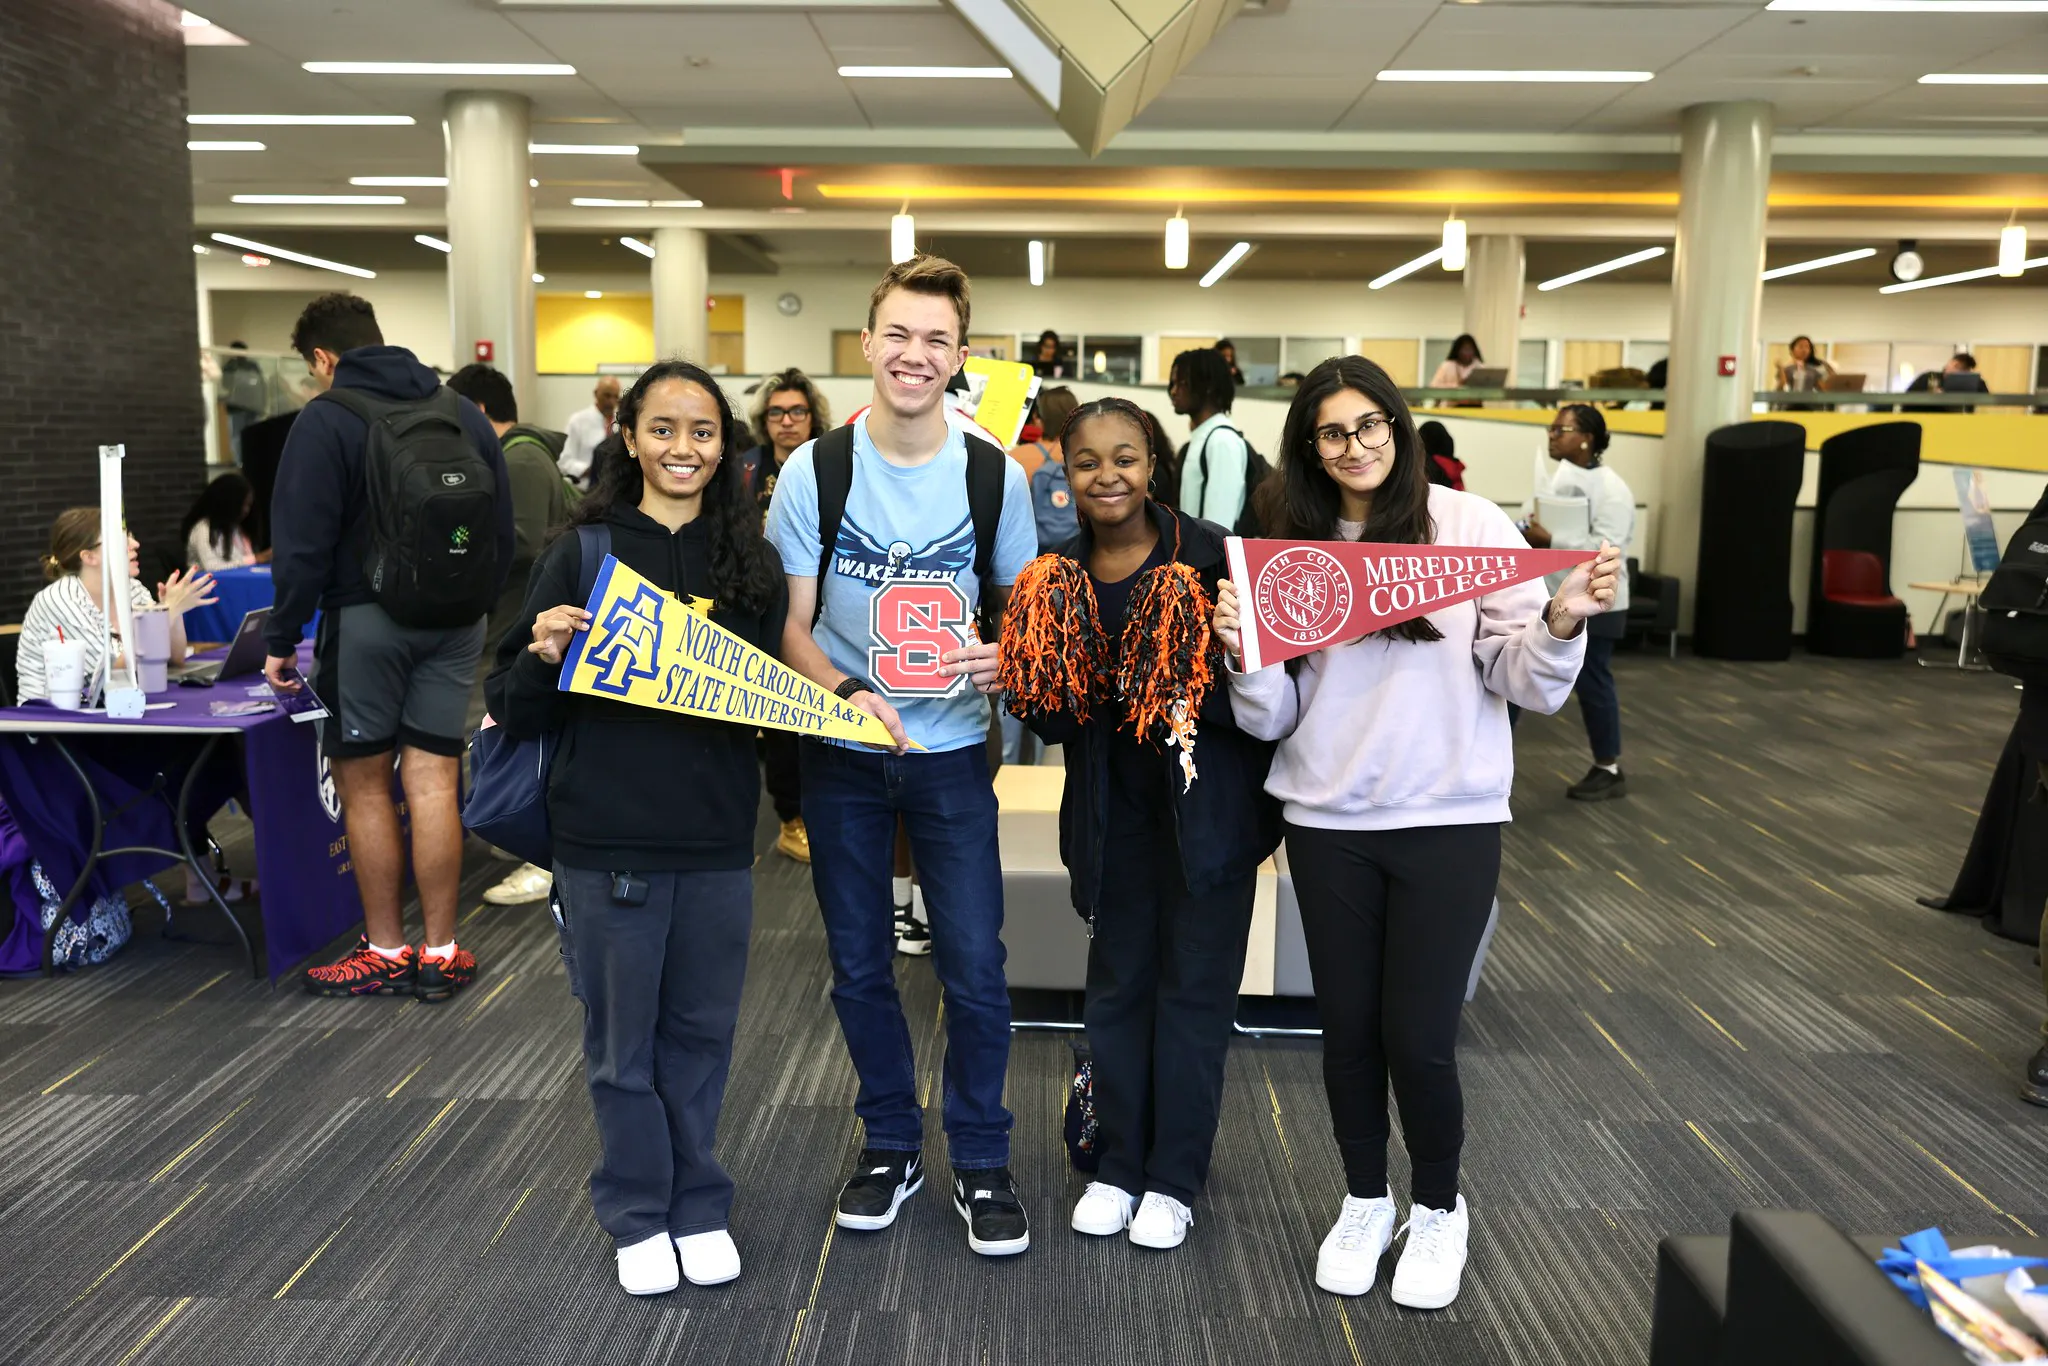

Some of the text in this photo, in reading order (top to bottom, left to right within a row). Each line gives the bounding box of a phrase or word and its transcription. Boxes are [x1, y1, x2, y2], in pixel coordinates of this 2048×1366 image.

[837, 557, 897, 581] WAKE
[1260, 552, 1348, 627] MEREDITH COLLEGE
[1362, 555, 1517, 587] MEREDITH
[1286, 585, 1317, 608] LUX
[1369, 567, 1519, 617] COLLEGE
[1293, 628, 1324, 641] 1891
[676, 613, 868, 727] NORTH CAROLINA A&T
[657, 663, 828, 730] STATE UNIVERSITY
